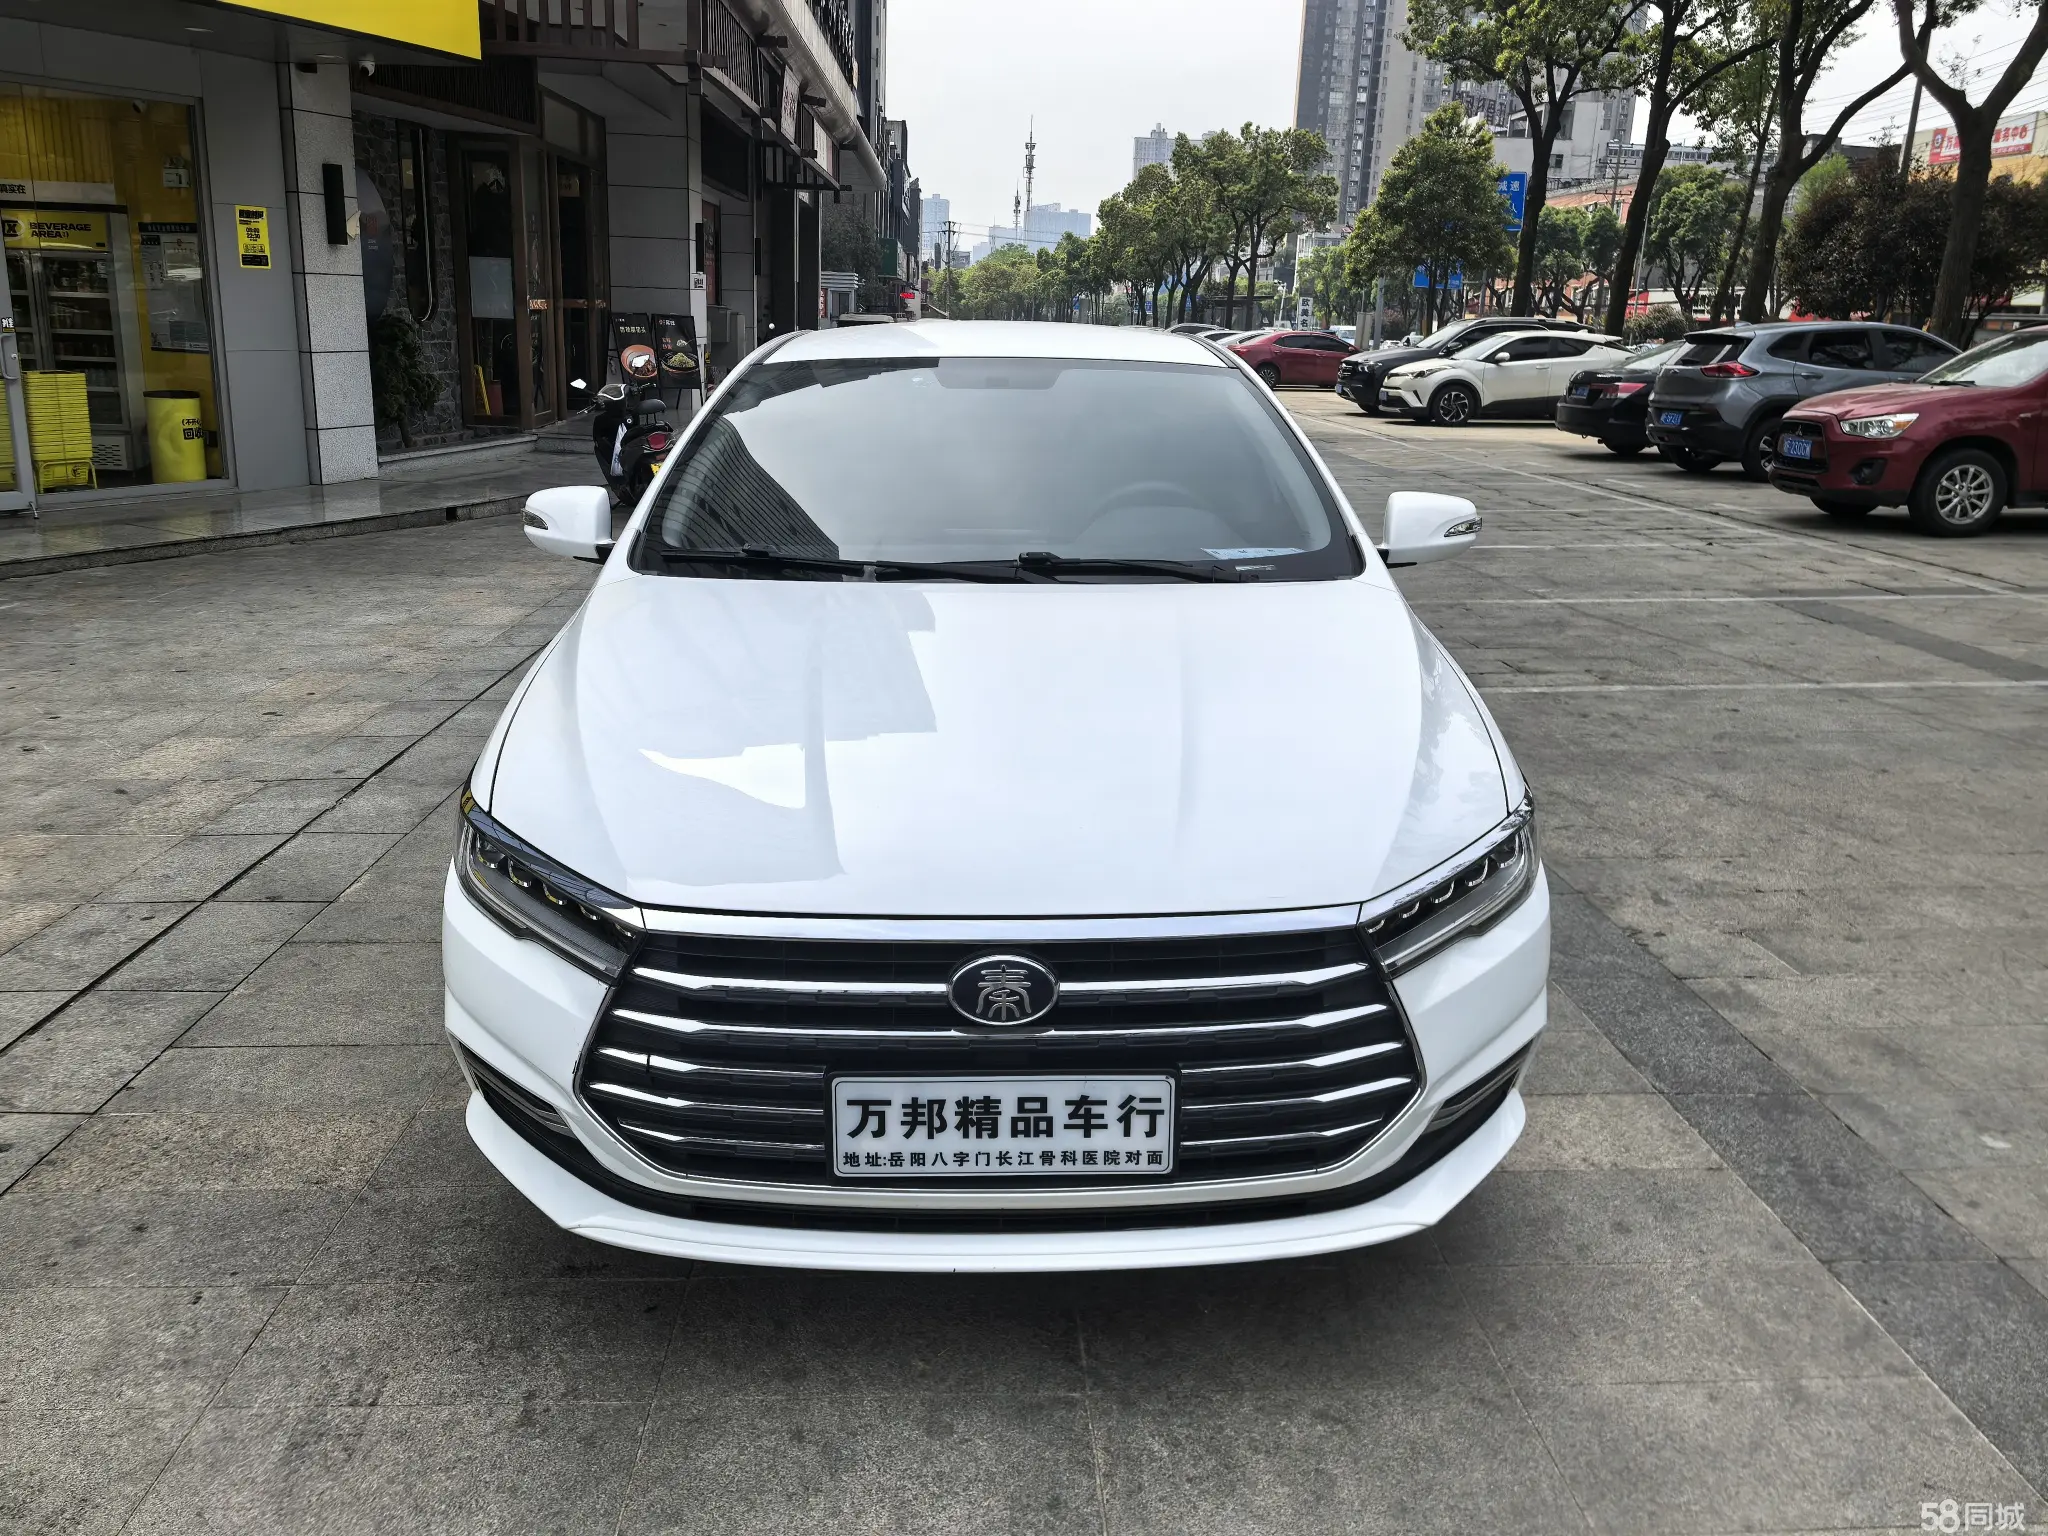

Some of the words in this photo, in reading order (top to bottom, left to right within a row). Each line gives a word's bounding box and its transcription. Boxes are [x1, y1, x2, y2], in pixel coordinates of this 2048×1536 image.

[30, 222, 92, 232] BEVERAGE
[1300, 298, 1311, 331] 欧美名
[975, 964, 1033, 1022] 秦
[846, 1094, 1165, 1139] 万邦精品车行
[843, 1150, 1163, 1168] 地址:岳阳八字门长江骨科医院对面
